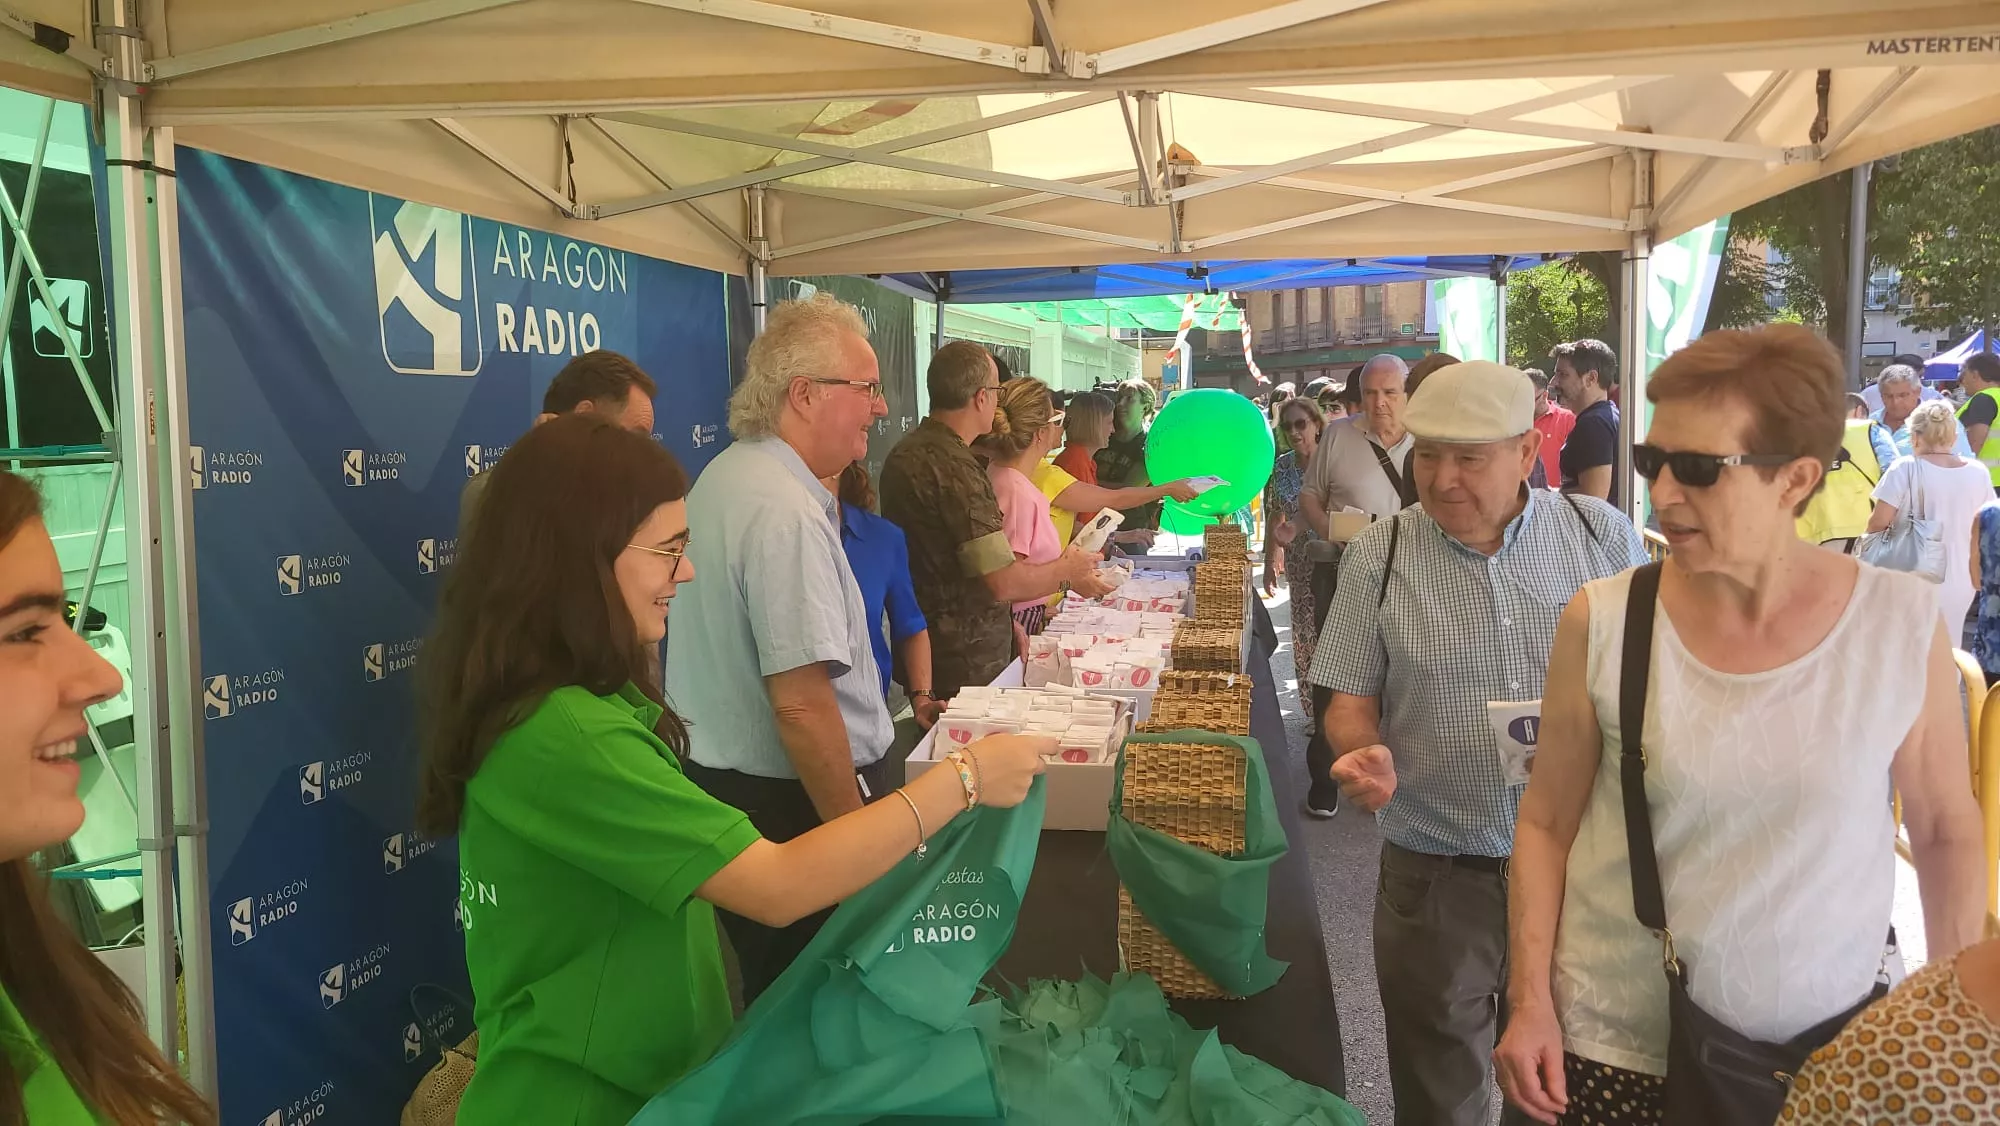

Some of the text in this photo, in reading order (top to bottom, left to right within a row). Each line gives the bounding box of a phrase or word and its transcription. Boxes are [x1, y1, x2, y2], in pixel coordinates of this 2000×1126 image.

[496, 302, 601, 357] RADIO
[211, 450, 263, 466] ARAGÓN
[368, 450, 406, 465] ARAGÓN
[212, 470, 252, 484] RADIO
[369, 468, 398, 481] RADIO
[307, 552, 350, 570] ARAGÓN
[309, 572, 341, 587] RADIO
[389, 655, 416, 672] RADIO
[234, 667, 285, 690] ARAGÓN
[236, 689, 278, 708] RADIO
[329, 751, 371, 776] ARAGÓN
[329, 770, 362, 791] RADIO
[259, 878, 308, 910] ARAGÓN
[260, 901, 298, 927] RADIO
[912, 898, 1000, 921] ARAGÓN
[913, 924, 976, 944] RADIO
[349, 944, 391, 975] ARAGÓN
[351, 964, 382, 990] RADIO
[288, 1080, 335, 1119] ARAGÓN
[289, 1104, 325, 1126] ADIO
